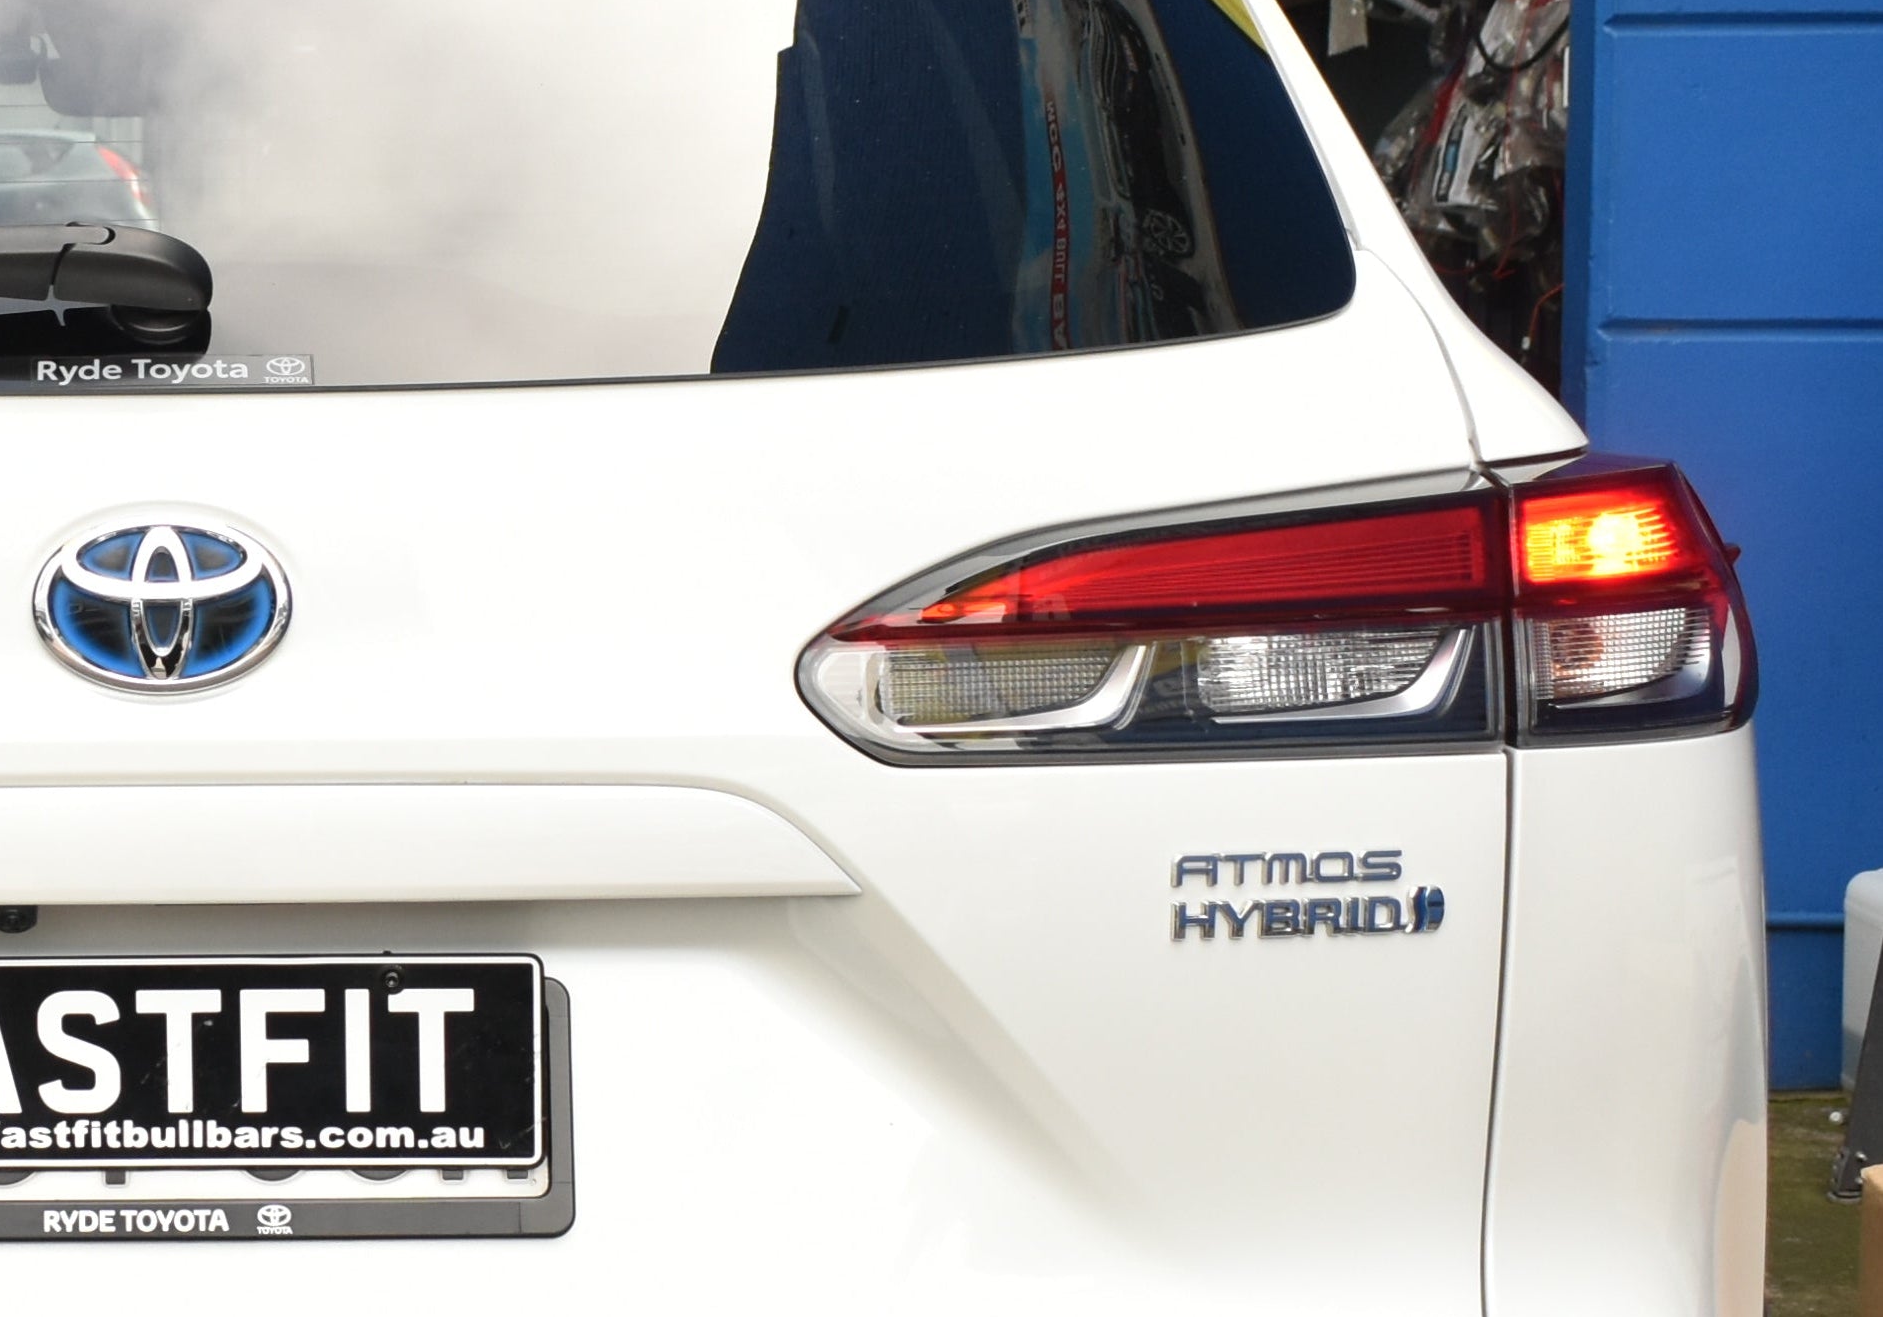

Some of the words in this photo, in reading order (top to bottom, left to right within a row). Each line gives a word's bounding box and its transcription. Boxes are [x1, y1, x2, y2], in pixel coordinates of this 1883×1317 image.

[37, 359, 123, 386] Ryde
[131, 358, 249, 384] Toyota
[264, 376, 309, 384] TOYOTA
[1170, 850, 1402, 887] ATMOS
[1171, 896, 1404, 941] HYBRID
[43, 1209, 116, 1233] RYDE
[119, 1208, 230, 1233] TOYOTA
[256, 1225, 294, 1235] TOYOTA
